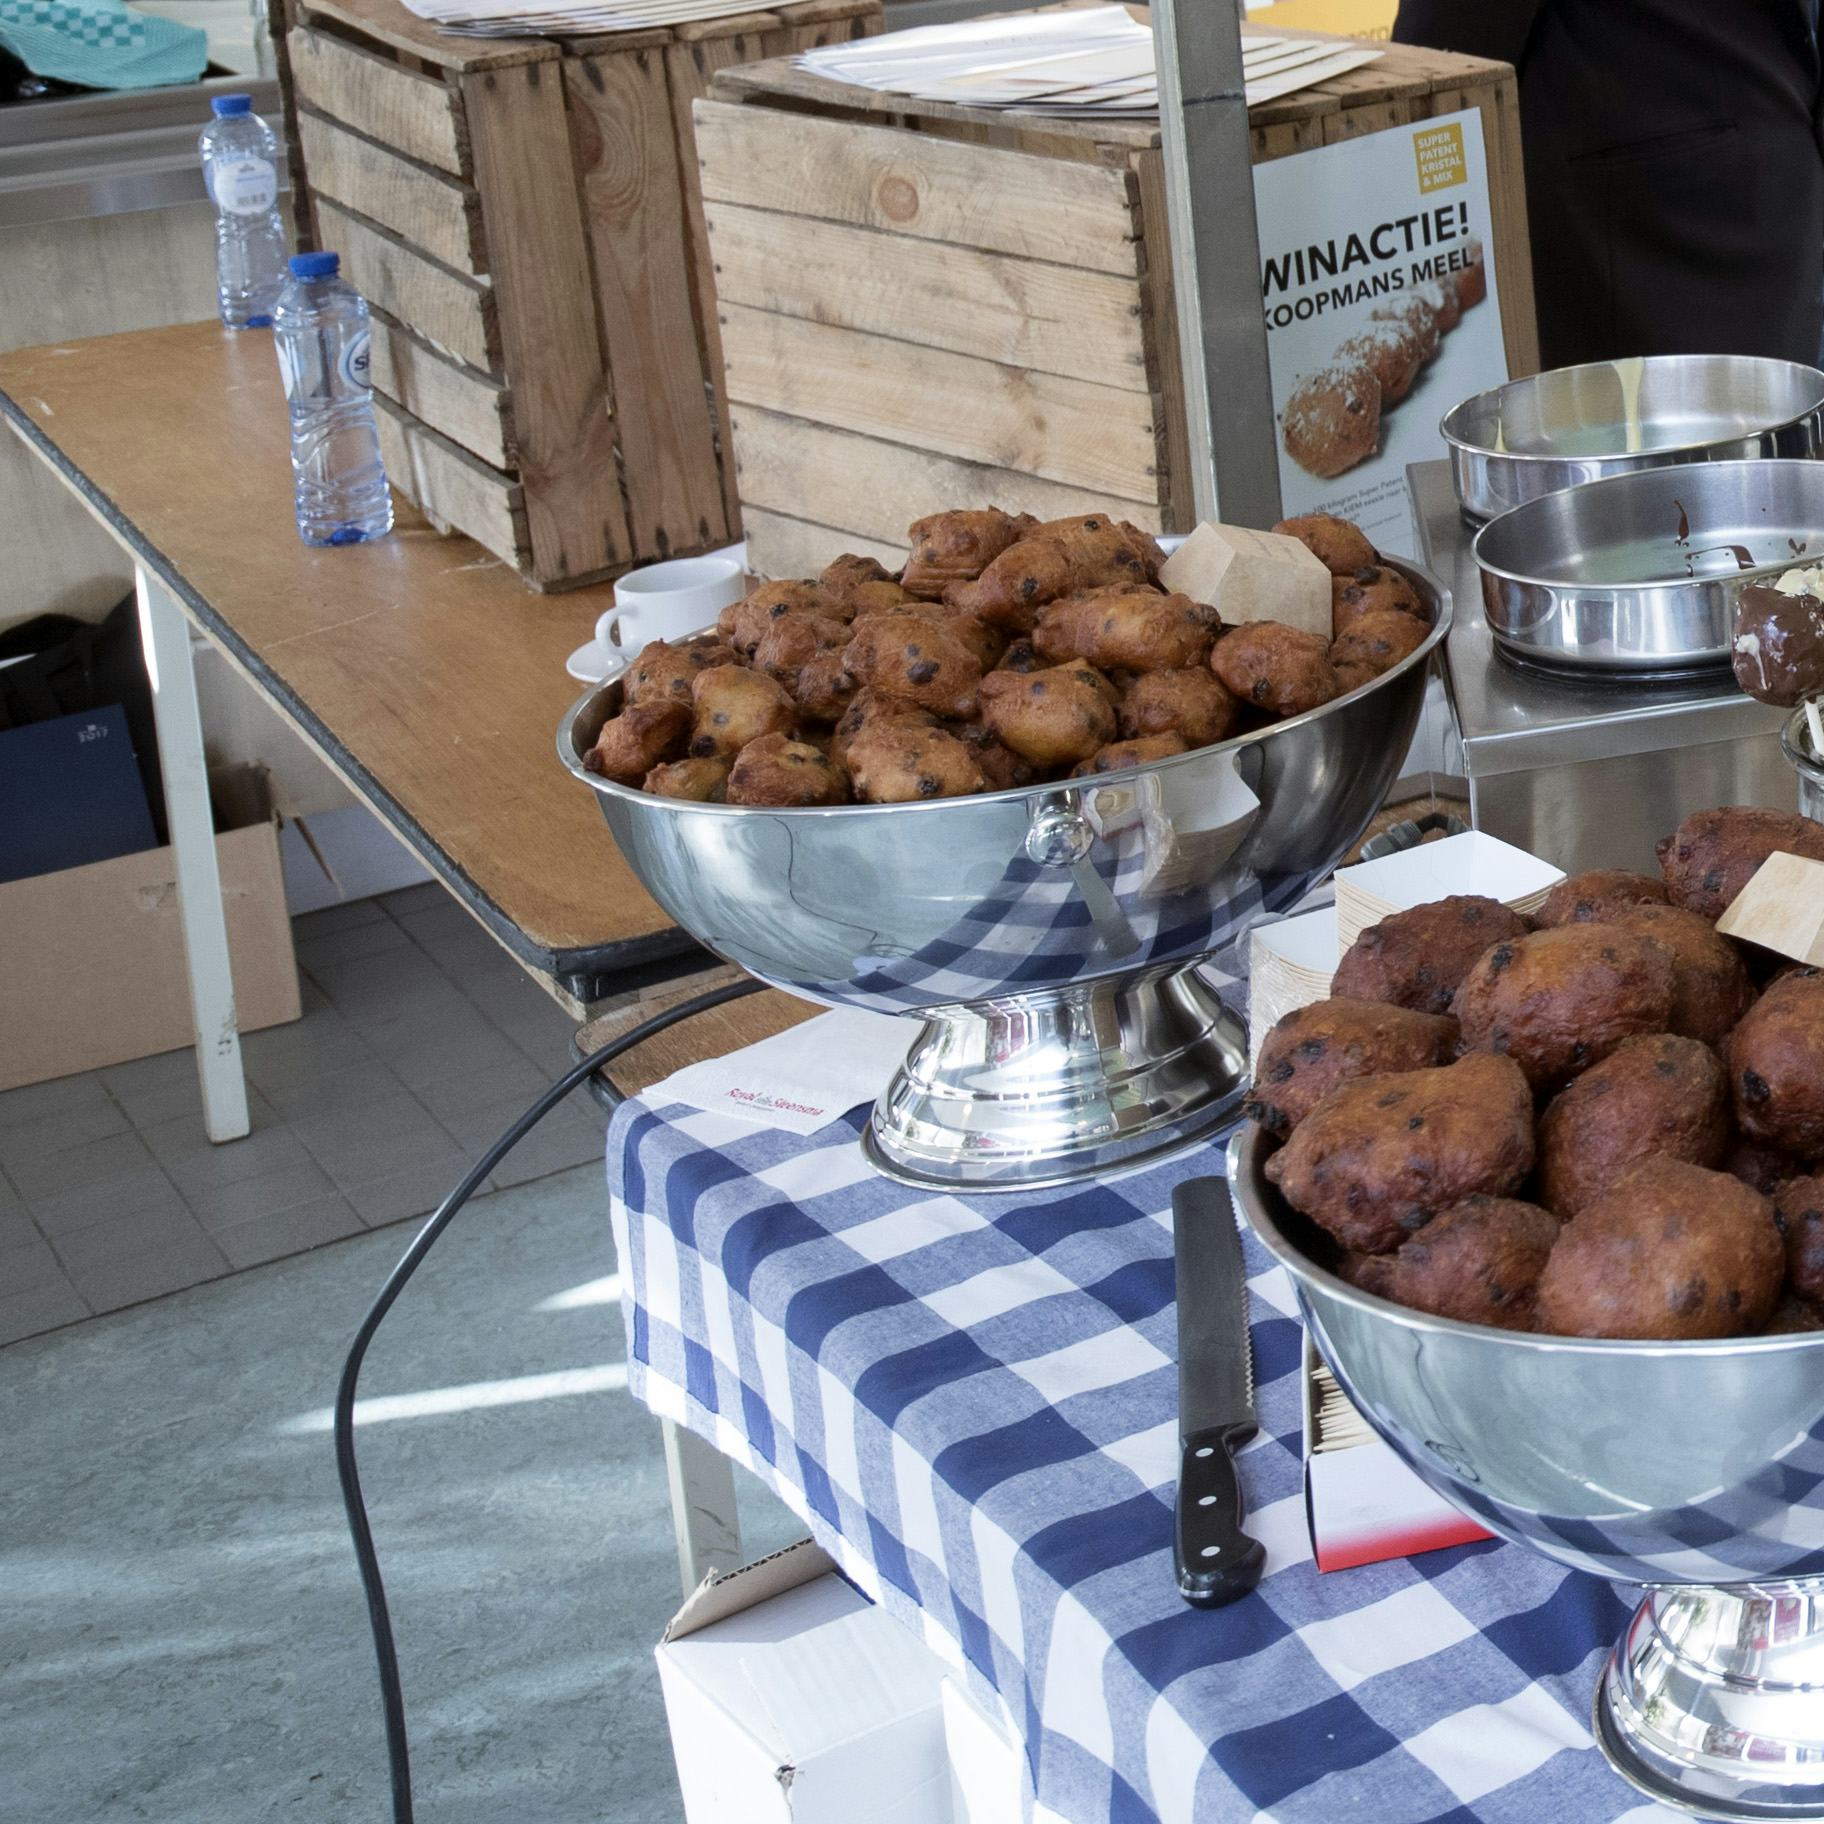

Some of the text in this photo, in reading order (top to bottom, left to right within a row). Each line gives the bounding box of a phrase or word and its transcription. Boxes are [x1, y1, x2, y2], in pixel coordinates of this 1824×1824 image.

[1418, 132, 1451, 149] SUPER
[1420, 143, 1457, 161] PATENT
[1422, 156, 1462, 174] KRISTAL
[1433, 170, 1453, 185] MIX
[1262, 201, 1470, 297] WINACTIE!
[1411, 246, 1475, 286] MEEL
